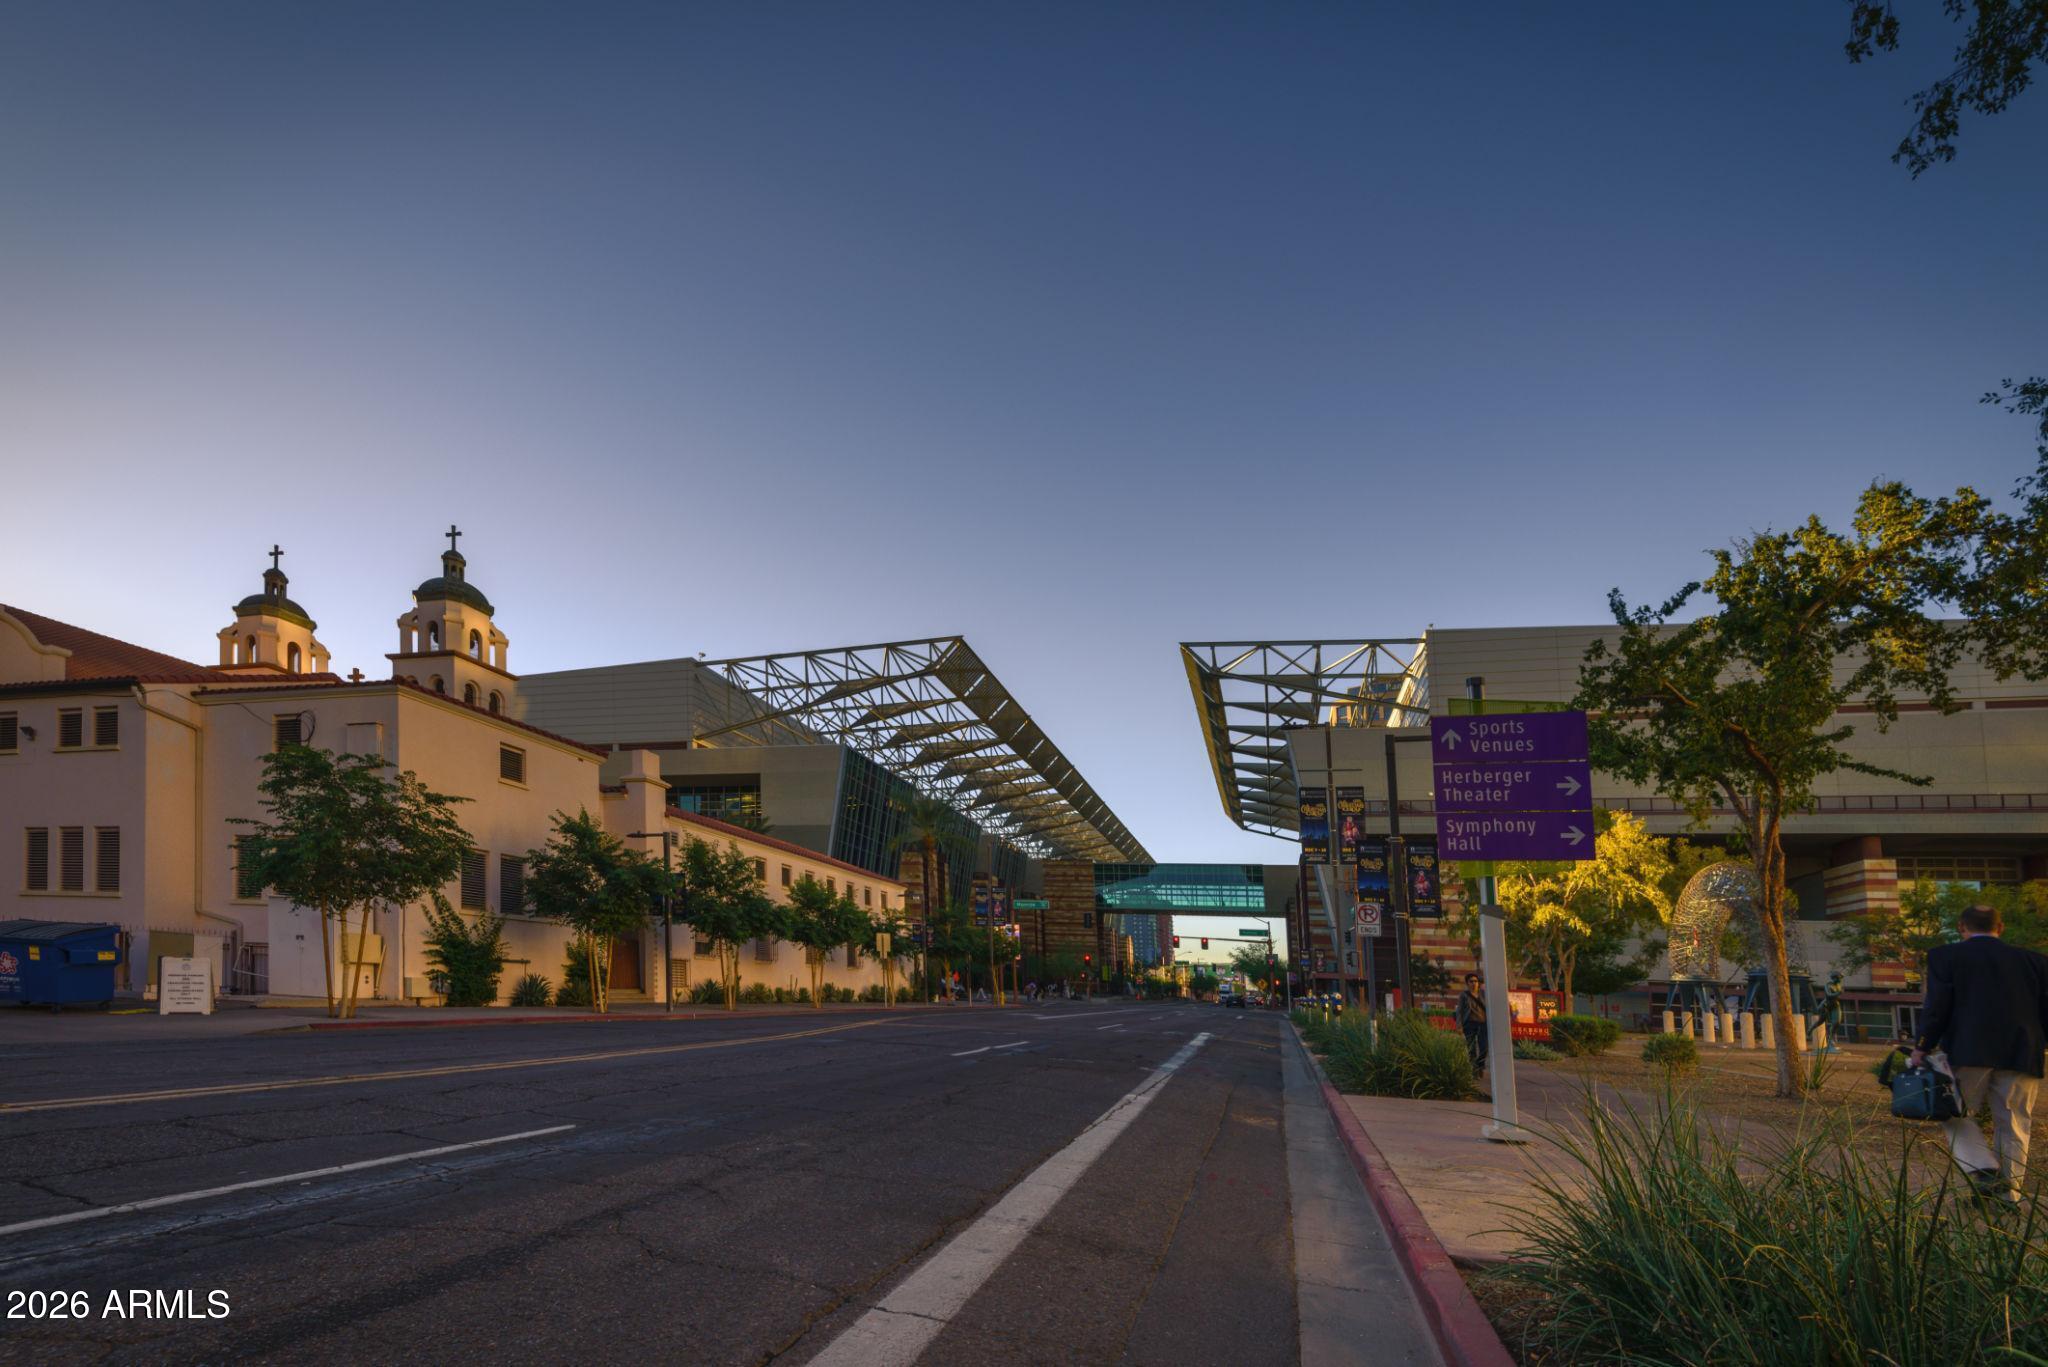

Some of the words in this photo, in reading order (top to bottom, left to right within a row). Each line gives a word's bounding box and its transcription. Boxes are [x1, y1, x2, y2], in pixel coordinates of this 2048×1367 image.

[1469, 720, 1525, 737] Sports
[1470, 739, 1535, 752] Venues
[1442, 770, 1532, 786] Herberger
[1443, 788, 1511, 801] Theater
[1446, 818, 1536, 836] Symphony
[1447, 836, 1482, 851] Hall
[1360, 925, 1377, 934] ENDS
